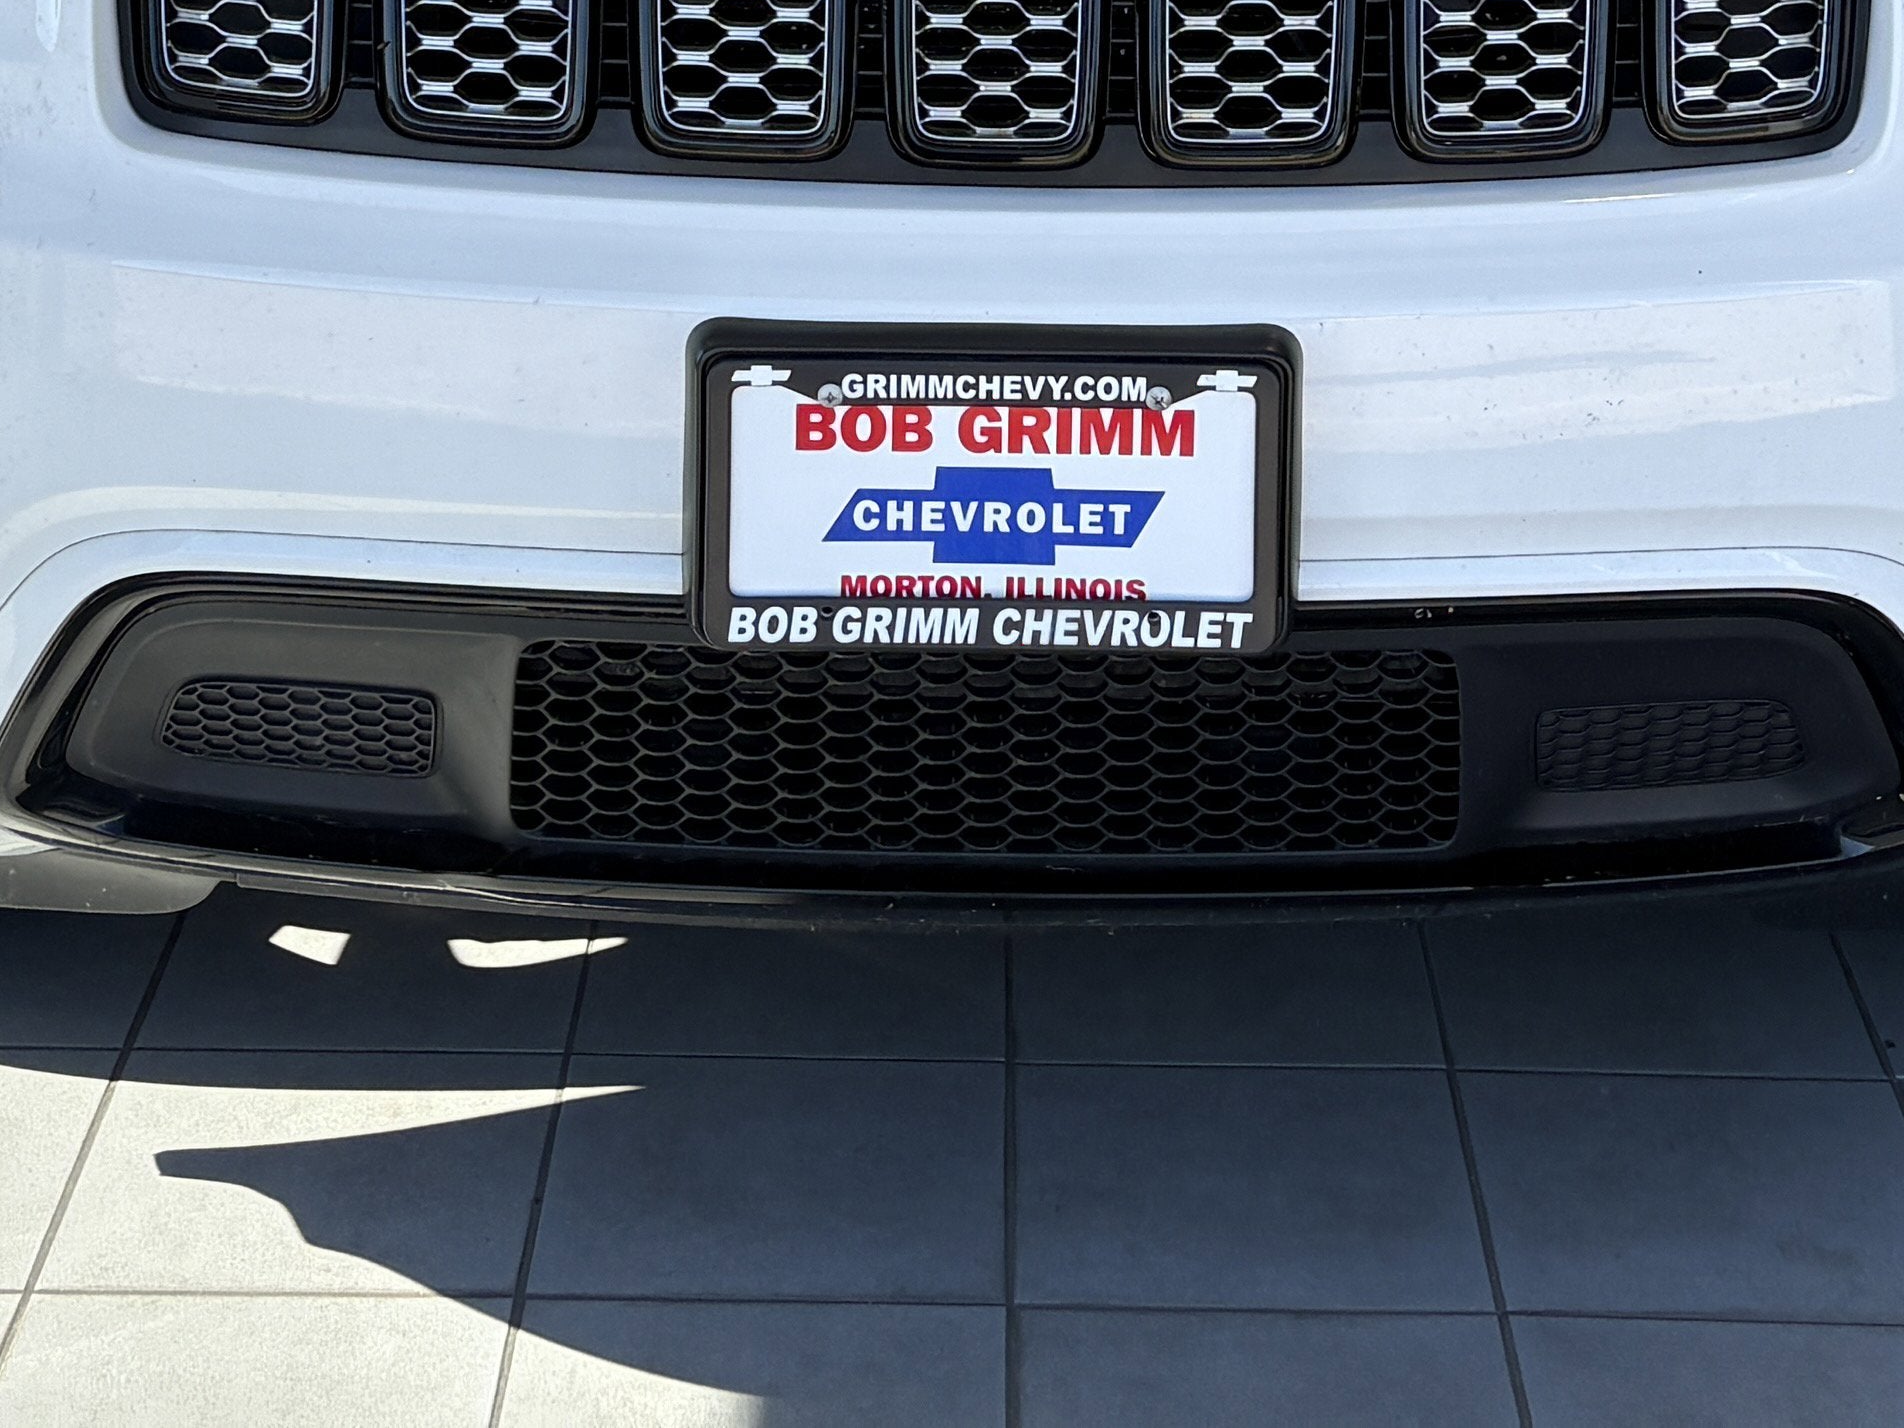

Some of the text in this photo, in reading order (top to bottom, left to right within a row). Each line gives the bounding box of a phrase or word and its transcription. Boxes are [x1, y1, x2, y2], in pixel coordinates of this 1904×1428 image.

[840, 372, 1148, 404] GRIMMCHEVY.COM
[795, 402, 1195, 458] BOB GRIMM
[852, 498, 1132, 536] CHEVROLET
[1005, 575, 1147, 602] ILLINOIS
[727, 605, 1254, 650] BOB GRIMM CHEVROLET
